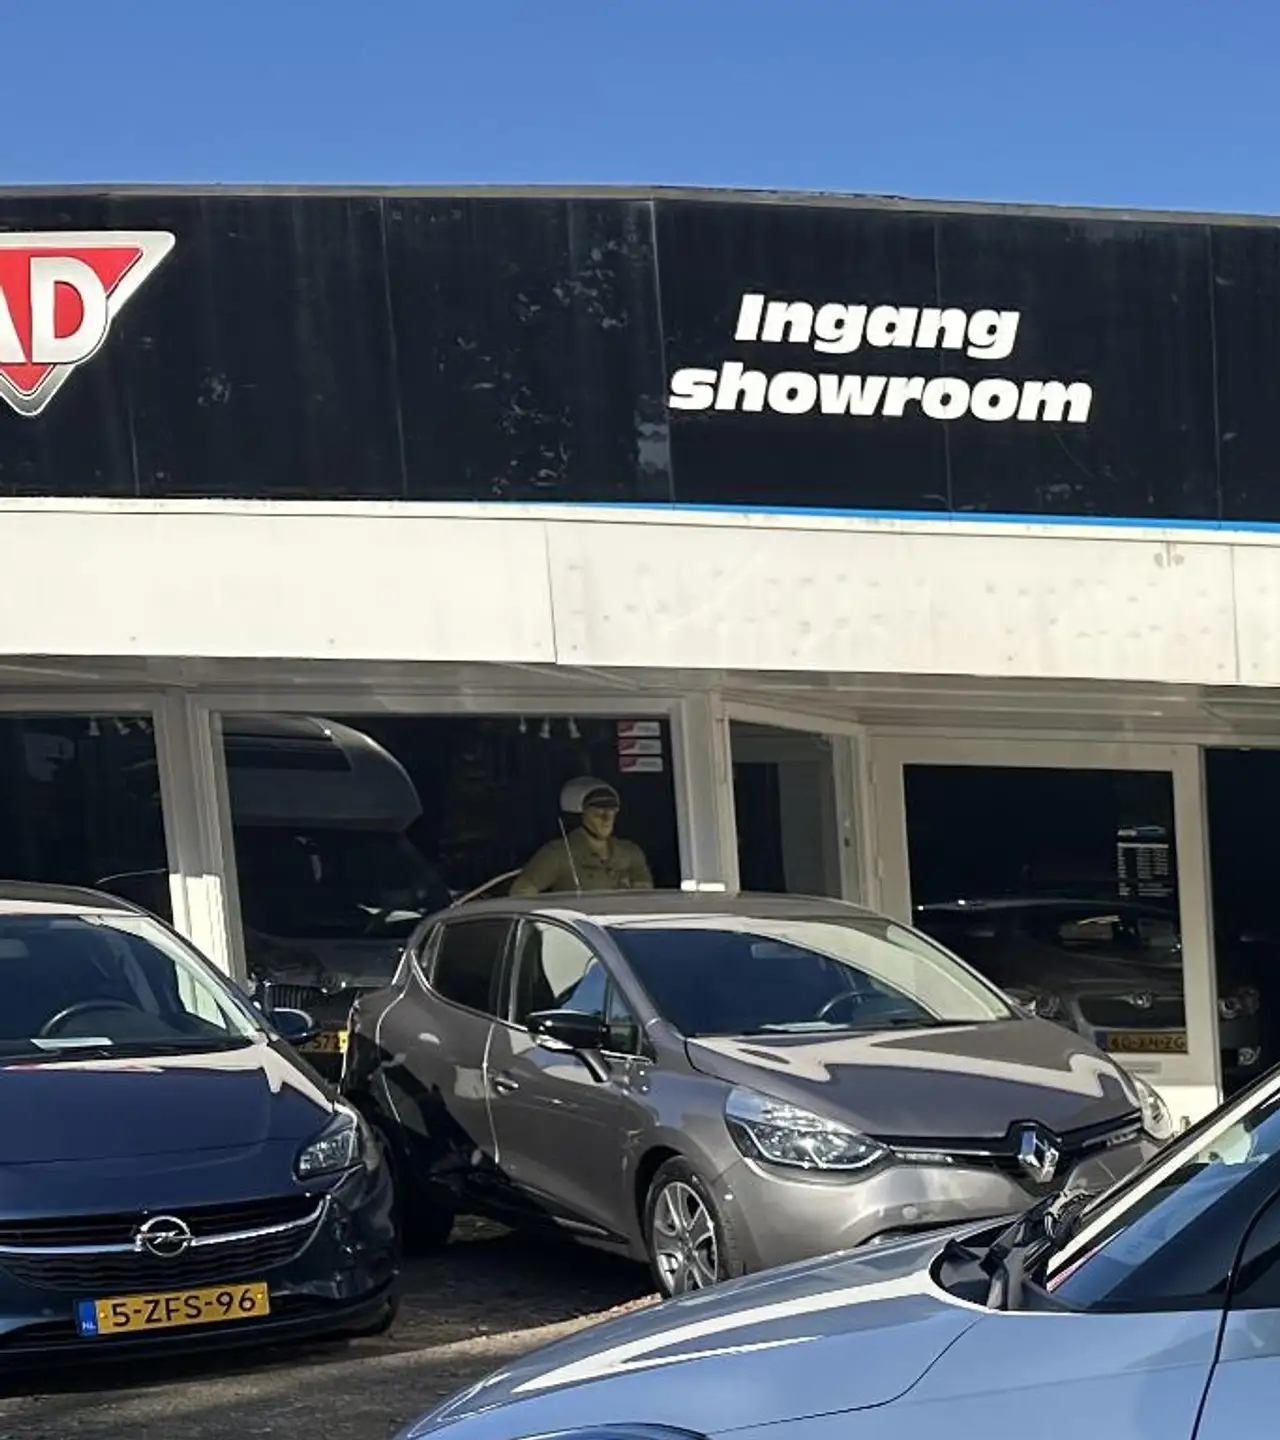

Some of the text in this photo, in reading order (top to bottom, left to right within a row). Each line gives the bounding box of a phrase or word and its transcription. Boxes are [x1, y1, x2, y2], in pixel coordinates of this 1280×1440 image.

[735, 294, 1020, 360] Ingang
[669, 362, 1093, 423] showroom
[82, 1320, 97, 1330] NL
[112, 1288, 256, 1327] 5-ZFS-96
